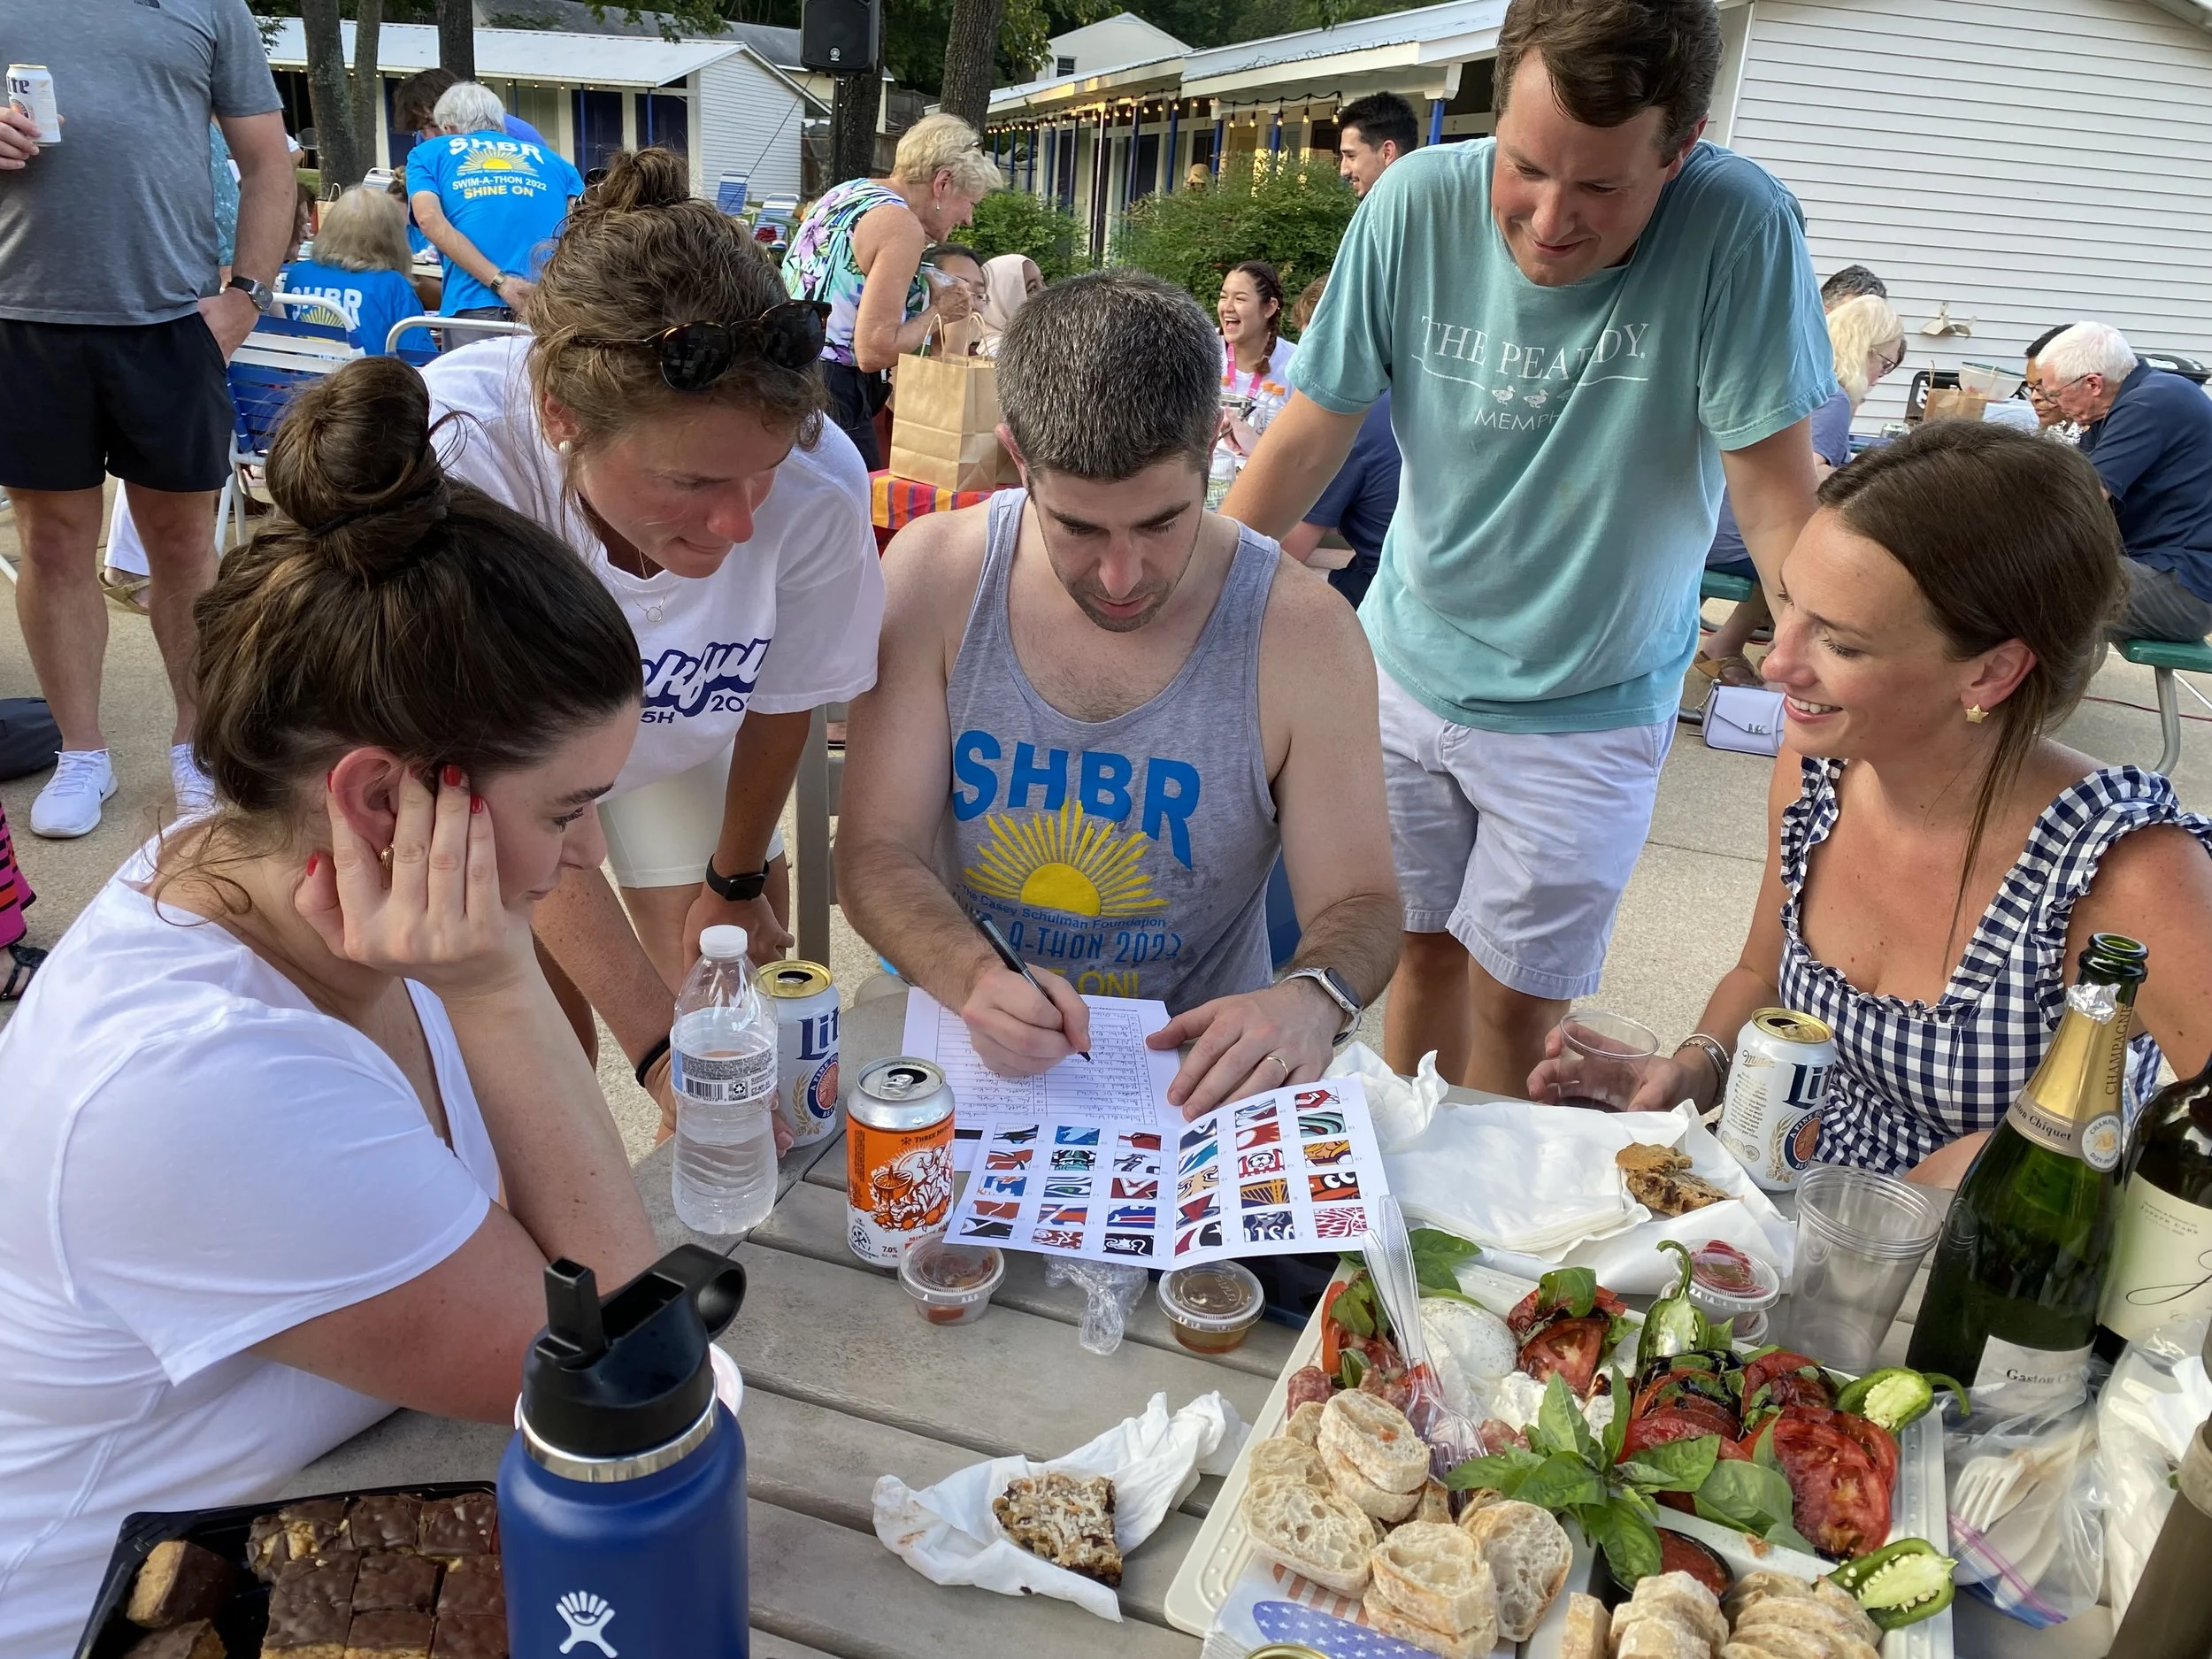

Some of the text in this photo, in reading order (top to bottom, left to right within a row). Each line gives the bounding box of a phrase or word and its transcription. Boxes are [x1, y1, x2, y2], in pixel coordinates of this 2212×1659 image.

[449, 137, 545, 165] SHBR
[452, 175, 548, 192] SWIM-A-THON 2022
[464, 184, 534, 199] SHINE ON
[1421, 315, 1649, 380] THE PEADY
[1474, 409, 1562, 432] MEMPH
[640, 711, 675, 724] 5K
[953, 729, 1201, 871] SHBR
[962, 885, 978, 902] The
[980, 895, 1018, 917] Casey
[1021, 908, 1089, 929] Schulman
[1092, 917, 1167, 930] Foundation
[795, 1006, 840, 1060] Lit
[2105, 1005, 2134, 1095] CHAMPAGNE
[1782, 1063, 1834, 1110] Lit
[914, 1132, 936, 1143] THREE
[2029, 1115, 2072, 1141] Chiquet
[881, 1245, 898, 1254] 7.0%
